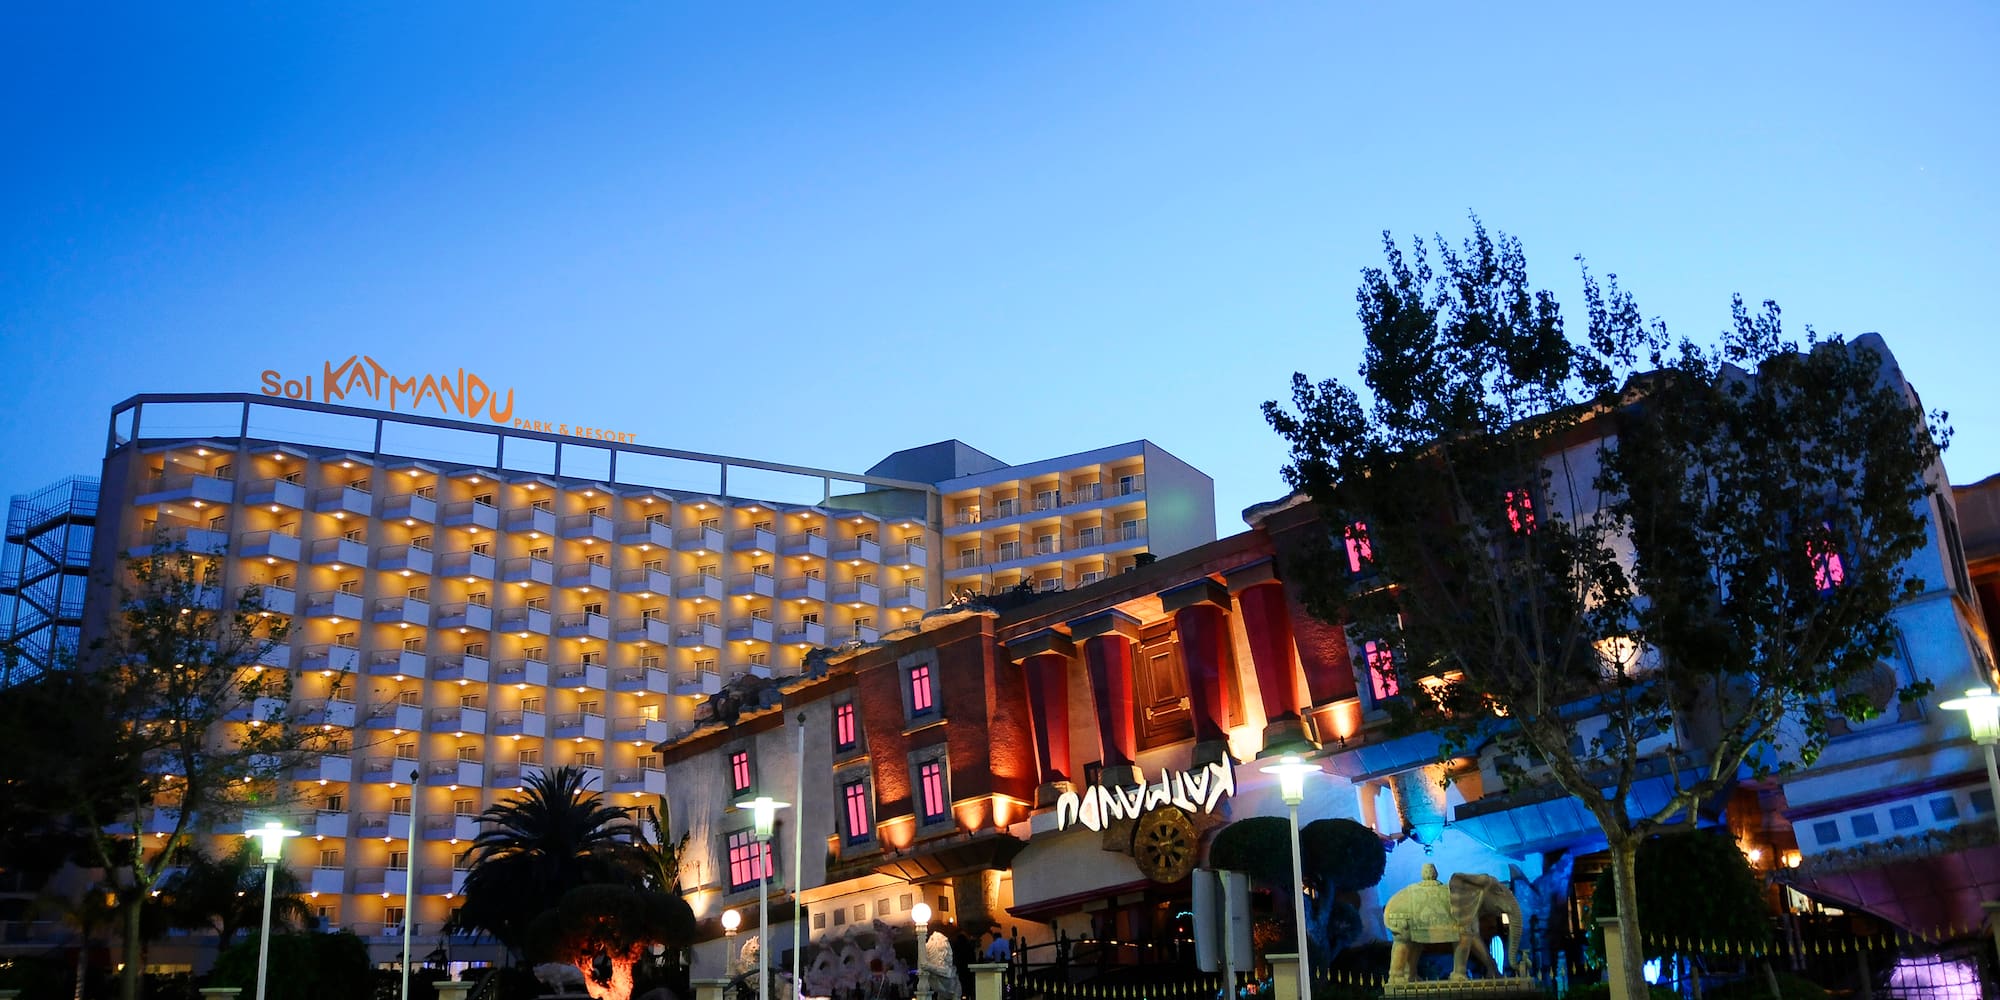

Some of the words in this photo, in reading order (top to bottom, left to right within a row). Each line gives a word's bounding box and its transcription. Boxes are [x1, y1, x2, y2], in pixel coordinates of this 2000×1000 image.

[261, 370, 312, 400] Sol
[323, 355, 514, 424] KATMANDU
[514, 418, 553, 433] PARK
[559, 424, 569, 437] &
[575, 426, 637, 444] RESORT
[1057, 751, 1236, 832] KATMANDU
